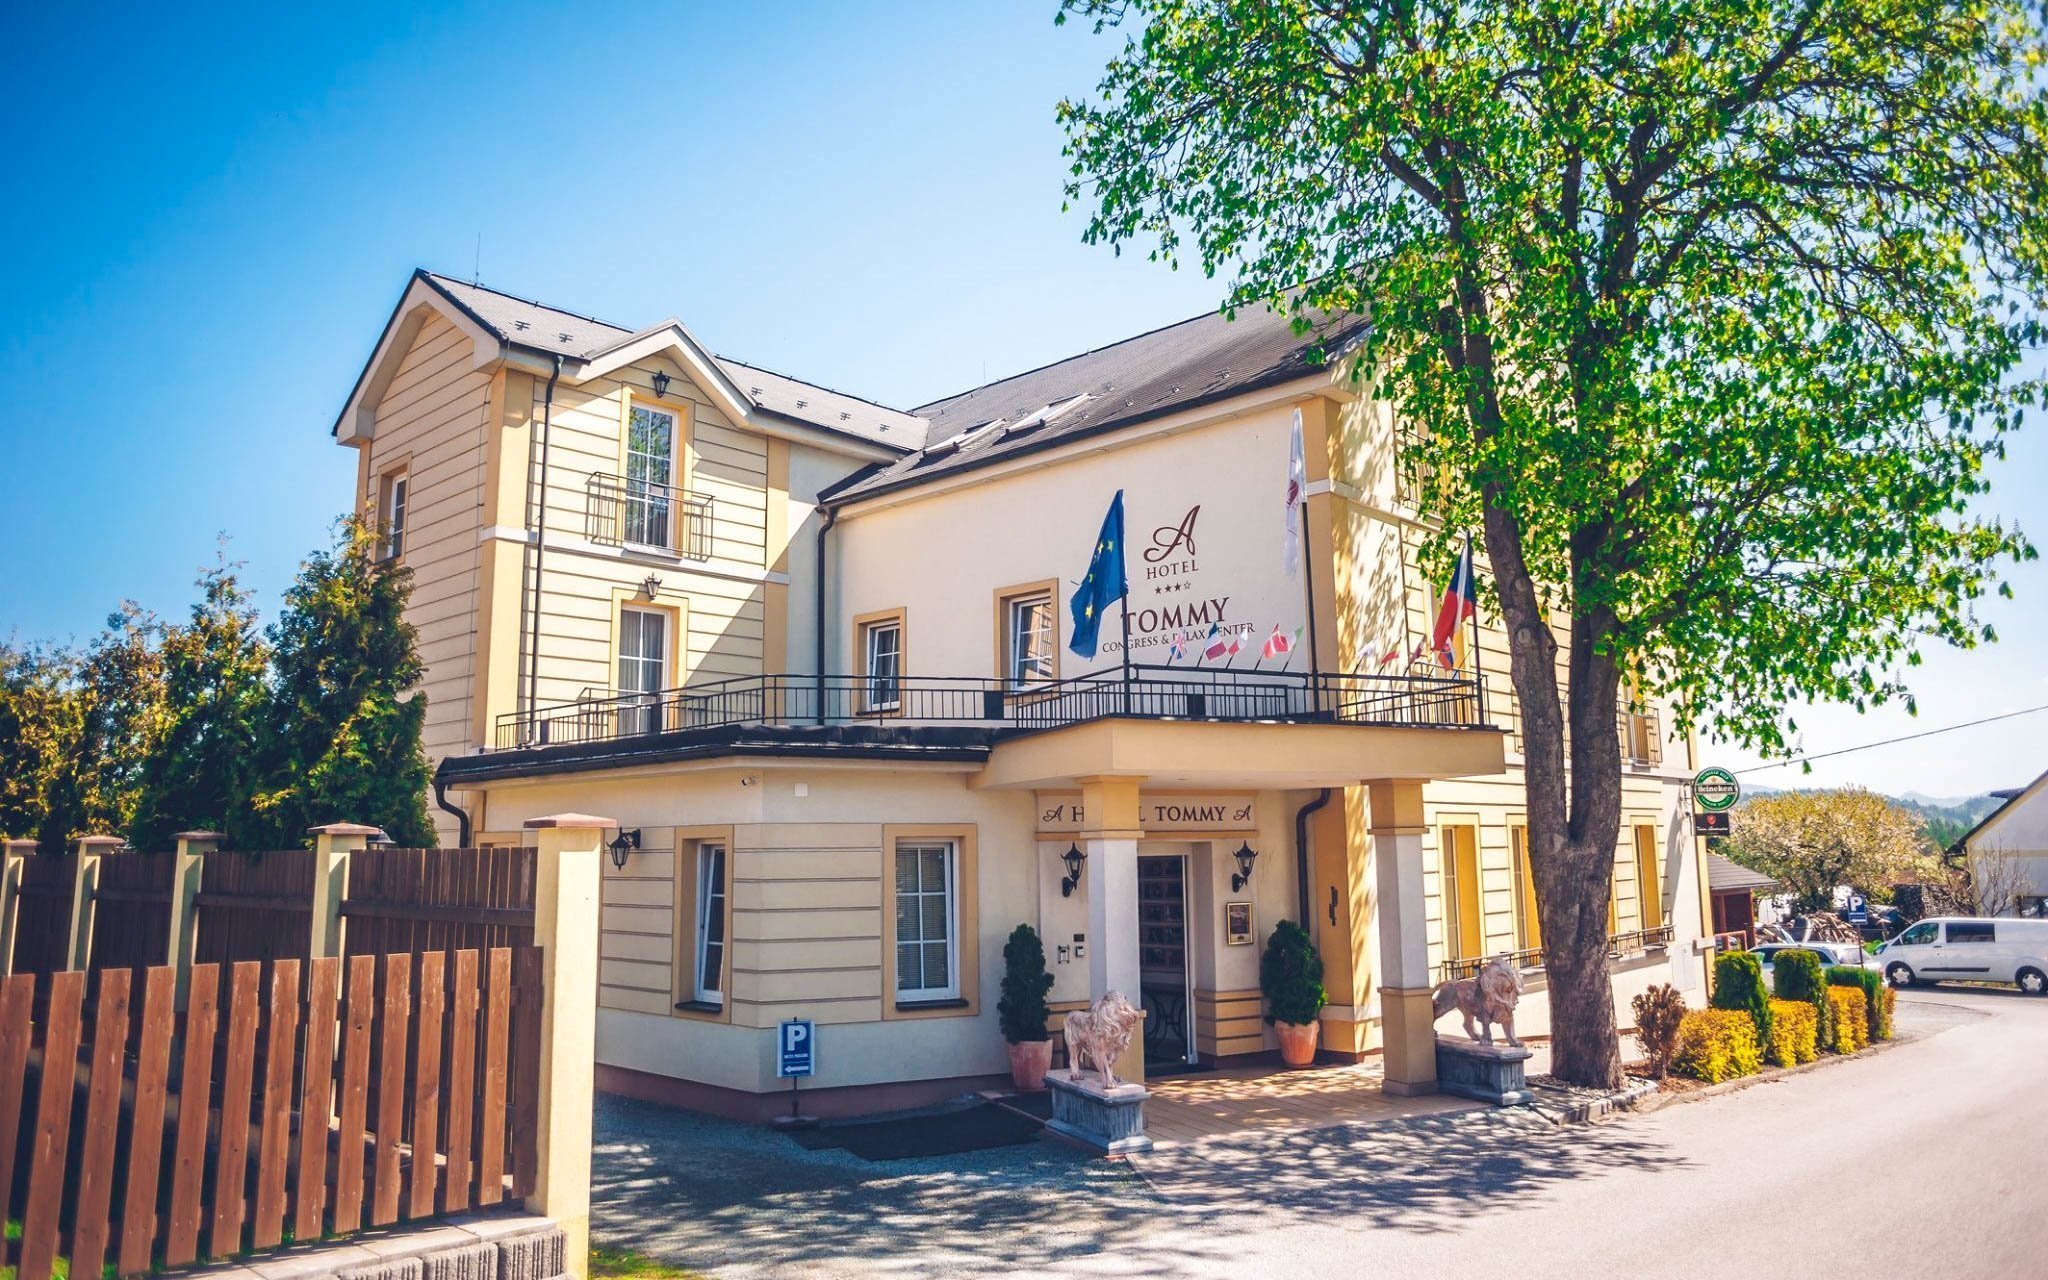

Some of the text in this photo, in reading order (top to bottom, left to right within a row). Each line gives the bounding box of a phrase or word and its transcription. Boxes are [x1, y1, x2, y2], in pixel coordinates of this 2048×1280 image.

[1145, 559, 1199, 580] HOTEL
[1120, 596, 1230, 636] TOMMY
[1161, 634, 1170, 645] &
[1172, 628, 1206, 643] LAX
[1697, 785, 1734, 793] Heineken
[1155, 805, 1227, 822] TOMMY
[1849, 896, 1863, 912] P
[787, 1024, 807, 1051] P
